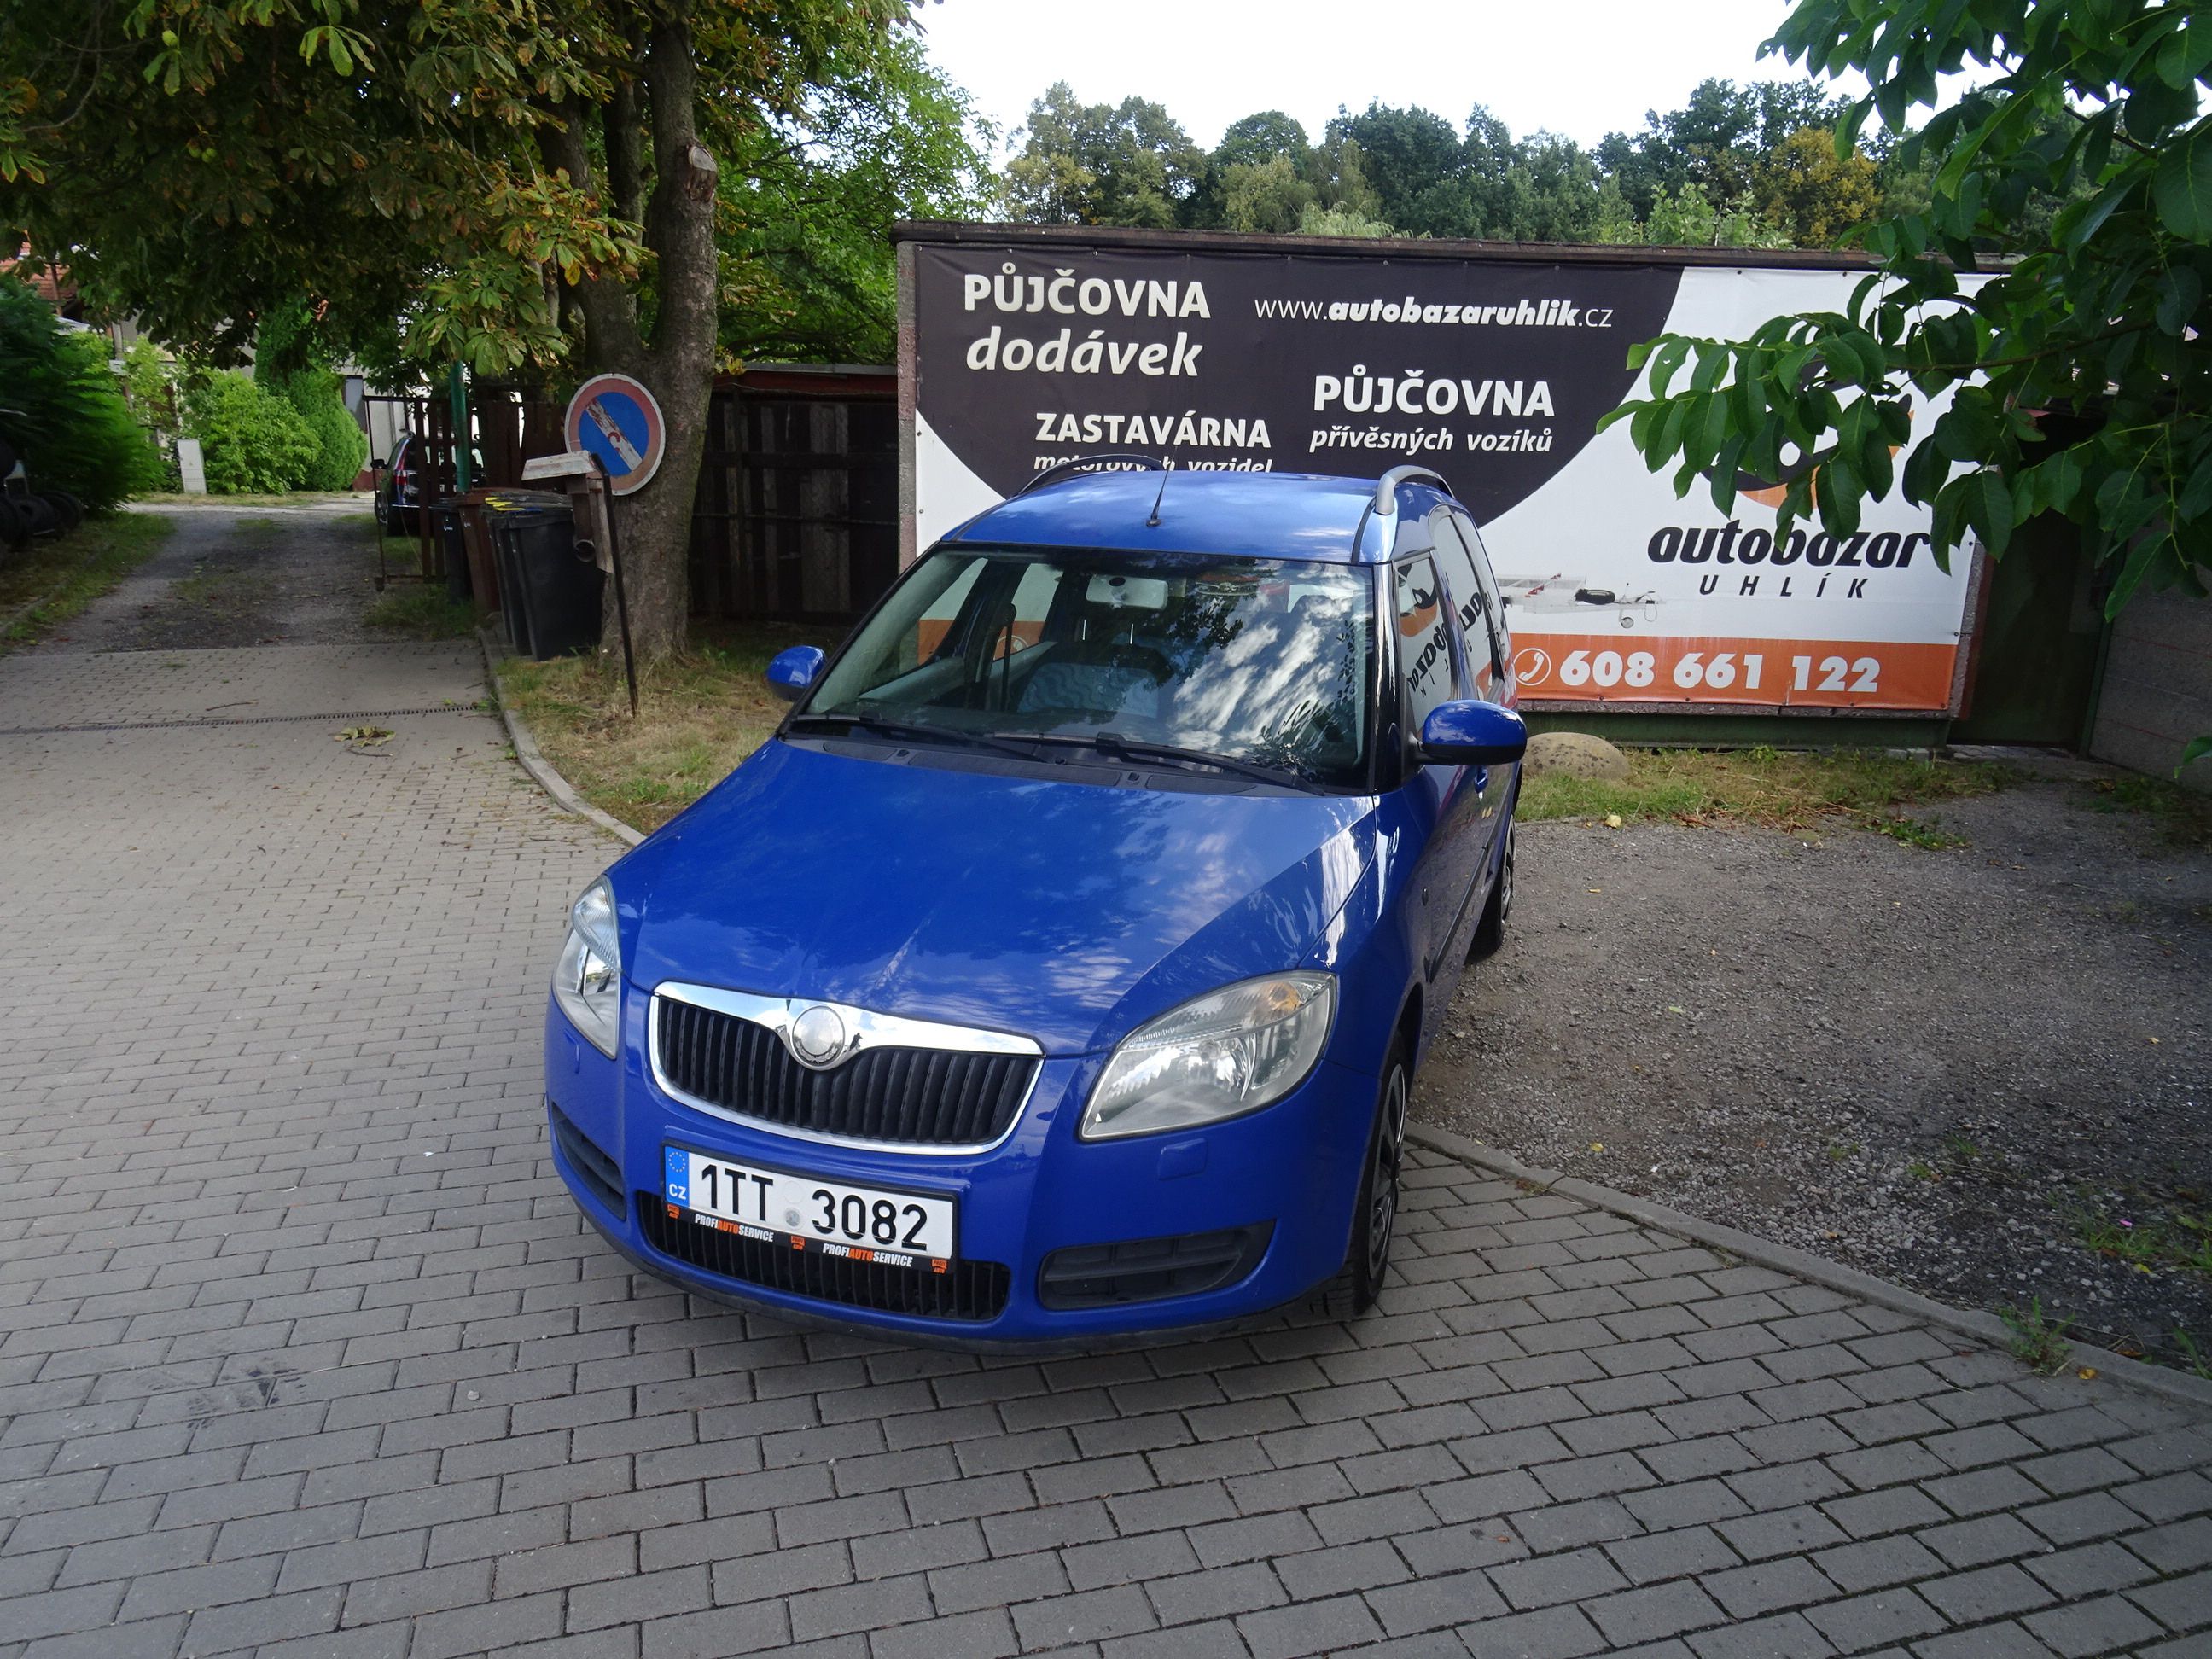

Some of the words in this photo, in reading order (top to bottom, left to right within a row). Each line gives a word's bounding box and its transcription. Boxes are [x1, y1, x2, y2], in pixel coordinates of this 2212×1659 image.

[965, 262, 1211, 318] PŮJČOVNA
[1255, 296, 1614, 328] www.autobazaruhlik.cz
[967, 326, 1203, 376] dodávek
[1314, 364, 1555, 416] PŮJČOVNA
[1035, 410, 1272, 448] ZASTAVÁRNA
[1309, 426, 1453, 456] přívěsných
[1467, 428, 1553, 452] vozíků
[1188, 457, 1273, 473] vozidel
[1648, 519, 1930, 568] autobazar
[1699, 573, 1868, 598] UHLÍK
[1560, 651, 1656, 687] 608
[1673, 653, 1763, 689] 661
[1792, 655, 1879, 692] 122
[669, 1183, 687, 1200] CZ
[701, 1164, 773, 1221] 1TT
[812, 1189, 928, 1252] 3082
[695, 1214, 775, 1243] PROFIAUTOSERVICE
[823, 1243, 913, 1267] PROFIAUTOSERVICE
